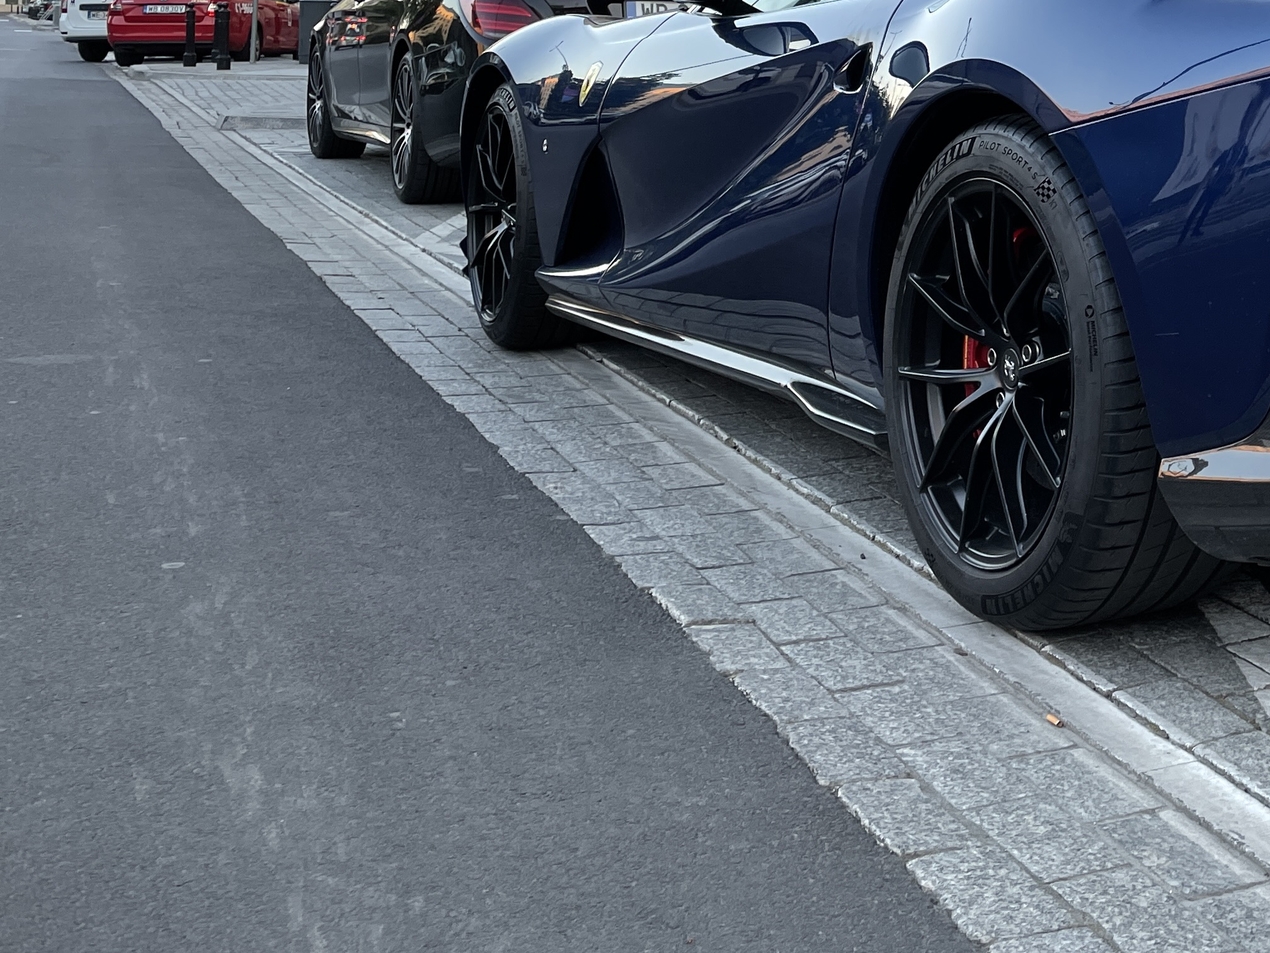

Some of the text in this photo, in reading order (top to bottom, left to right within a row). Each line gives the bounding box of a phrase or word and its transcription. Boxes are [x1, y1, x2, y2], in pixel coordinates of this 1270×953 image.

[907, 138, 973, 221] MICHELIN
[979, 140, 1001, 151] PILOT
[1002, 147, 1029, 169] SPORT
[1090, 320, 1099, 357] MICHELIN
[985, 545, 1064, 615] MICHELIN
